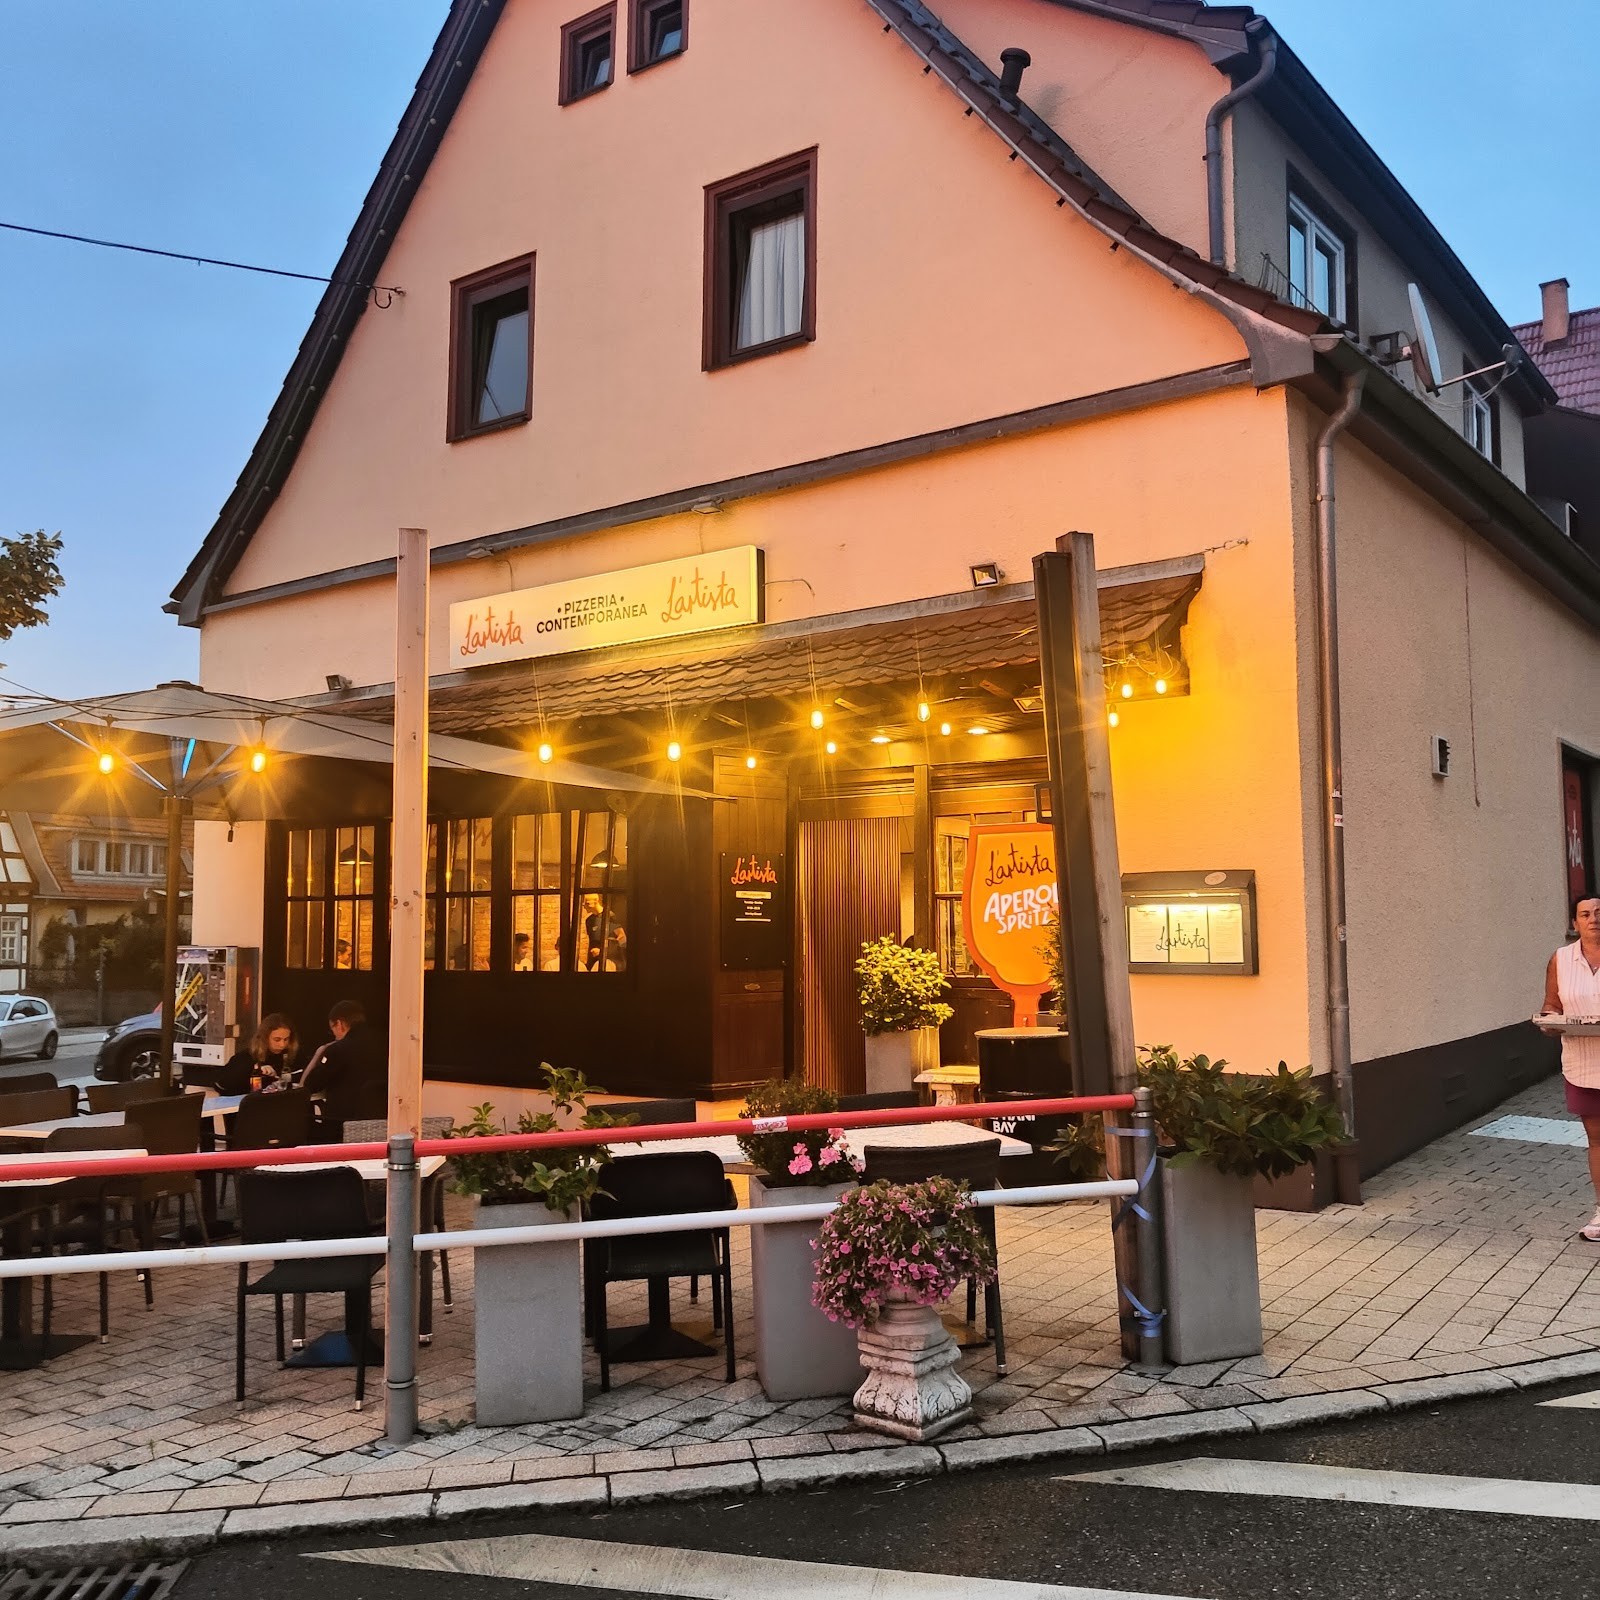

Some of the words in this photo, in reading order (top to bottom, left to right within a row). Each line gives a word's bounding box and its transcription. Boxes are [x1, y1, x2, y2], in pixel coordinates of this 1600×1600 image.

[564, 594, 618, 615] PIZZERIA
[661, 567, 739, 623] L'artista
[460, 606, 524, 656] L'artista
[536, 603, 648, 634] CONTEMPORANEA
[731, 854, 778, 885] L'artista
[985, 842, 1053, 887] L'artista
[992, 1120, 1017, 1134] BAY
